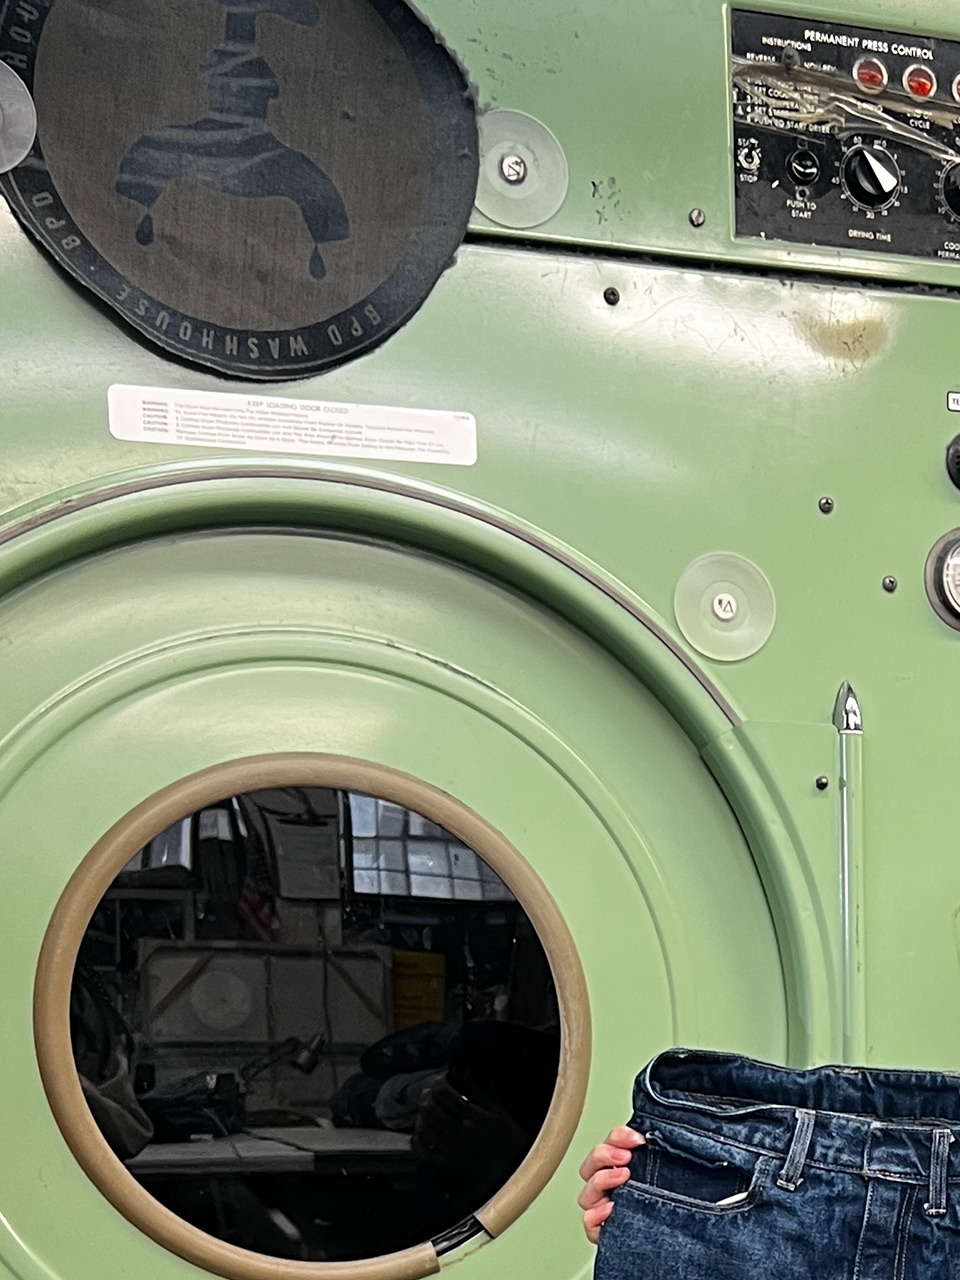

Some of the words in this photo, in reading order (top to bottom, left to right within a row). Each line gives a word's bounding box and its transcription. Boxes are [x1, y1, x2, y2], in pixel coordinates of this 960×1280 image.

[803, 29, 860, 48] PERMANENT
[861, 39, 889, 53] PRESS
[890, 45, 934, 61] CONTROL
[909, 118, 931, 130] CYCLE
[739, 173, 758, 183] STOP
[786, 199, 805, 210] PUSH
[806, 202, 817, 211] TO
[791, 209, 812, 220] START
[848, 228, 875, 241] DRYING
[875, 231, 892, 243] TIME
[115, 283, 309, 360] WASHHOUSE
